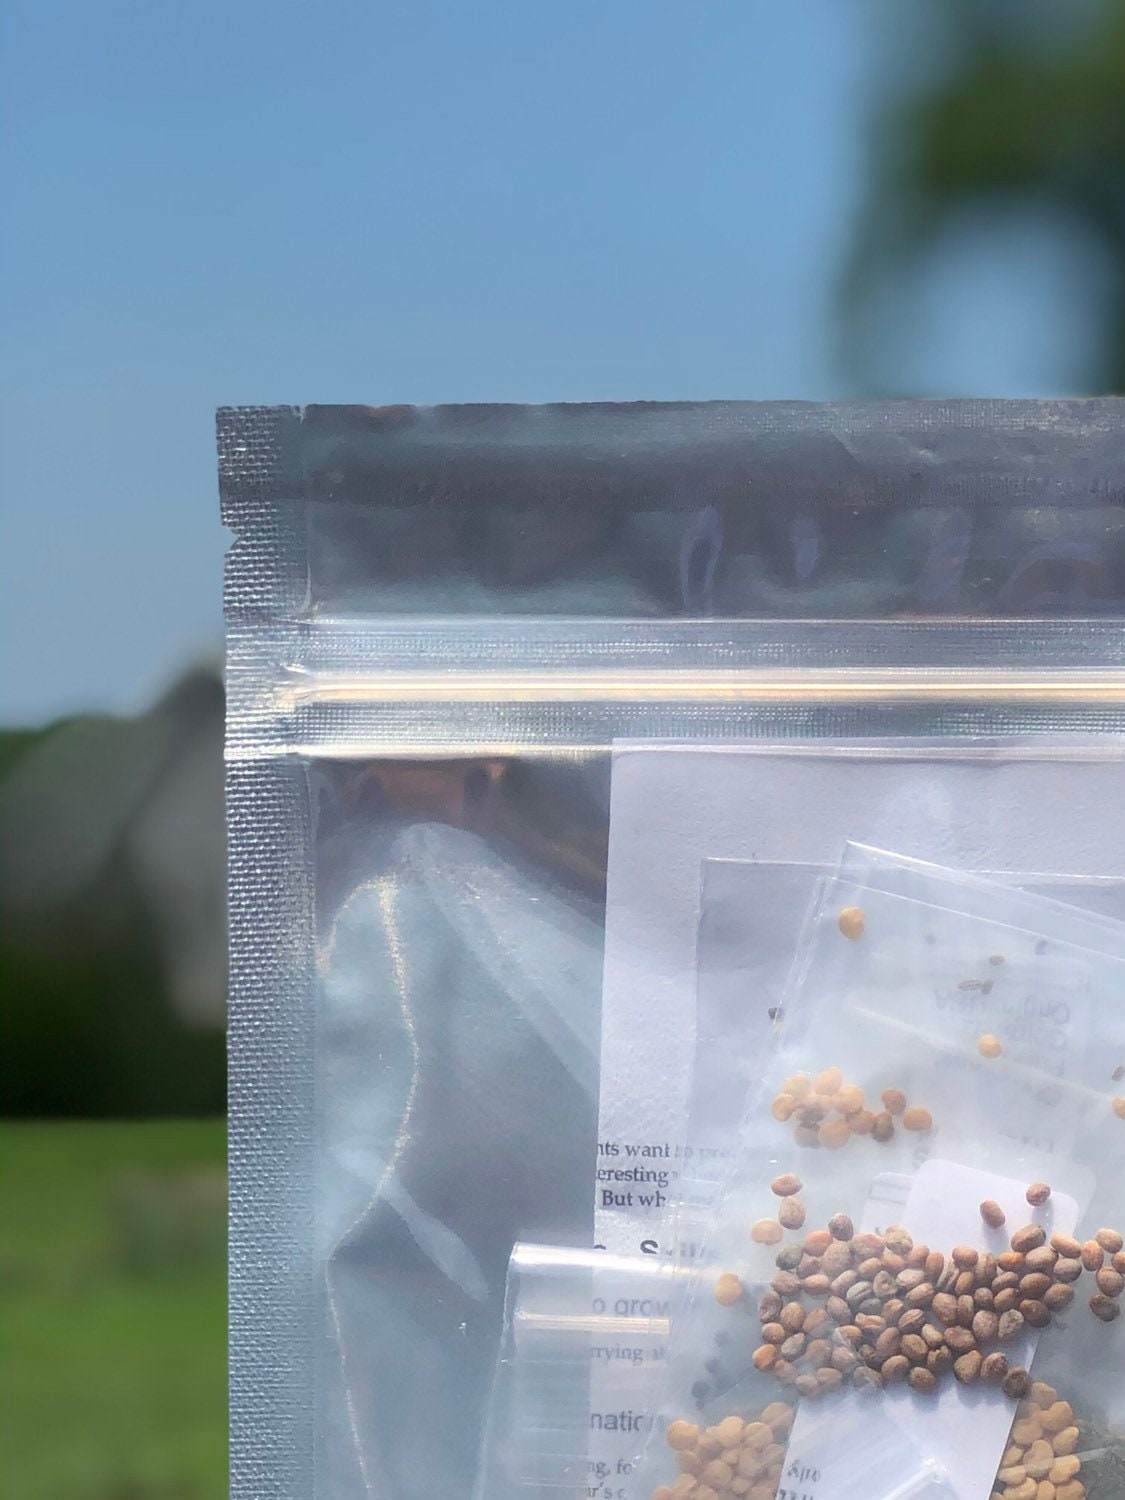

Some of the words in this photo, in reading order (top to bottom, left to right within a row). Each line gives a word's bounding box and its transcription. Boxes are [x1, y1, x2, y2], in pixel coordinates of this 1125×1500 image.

[625, 1143, 670, 1158] want
[596, 1166, 669, 1188] eresting
[602, 1189, 634, 1207] But
